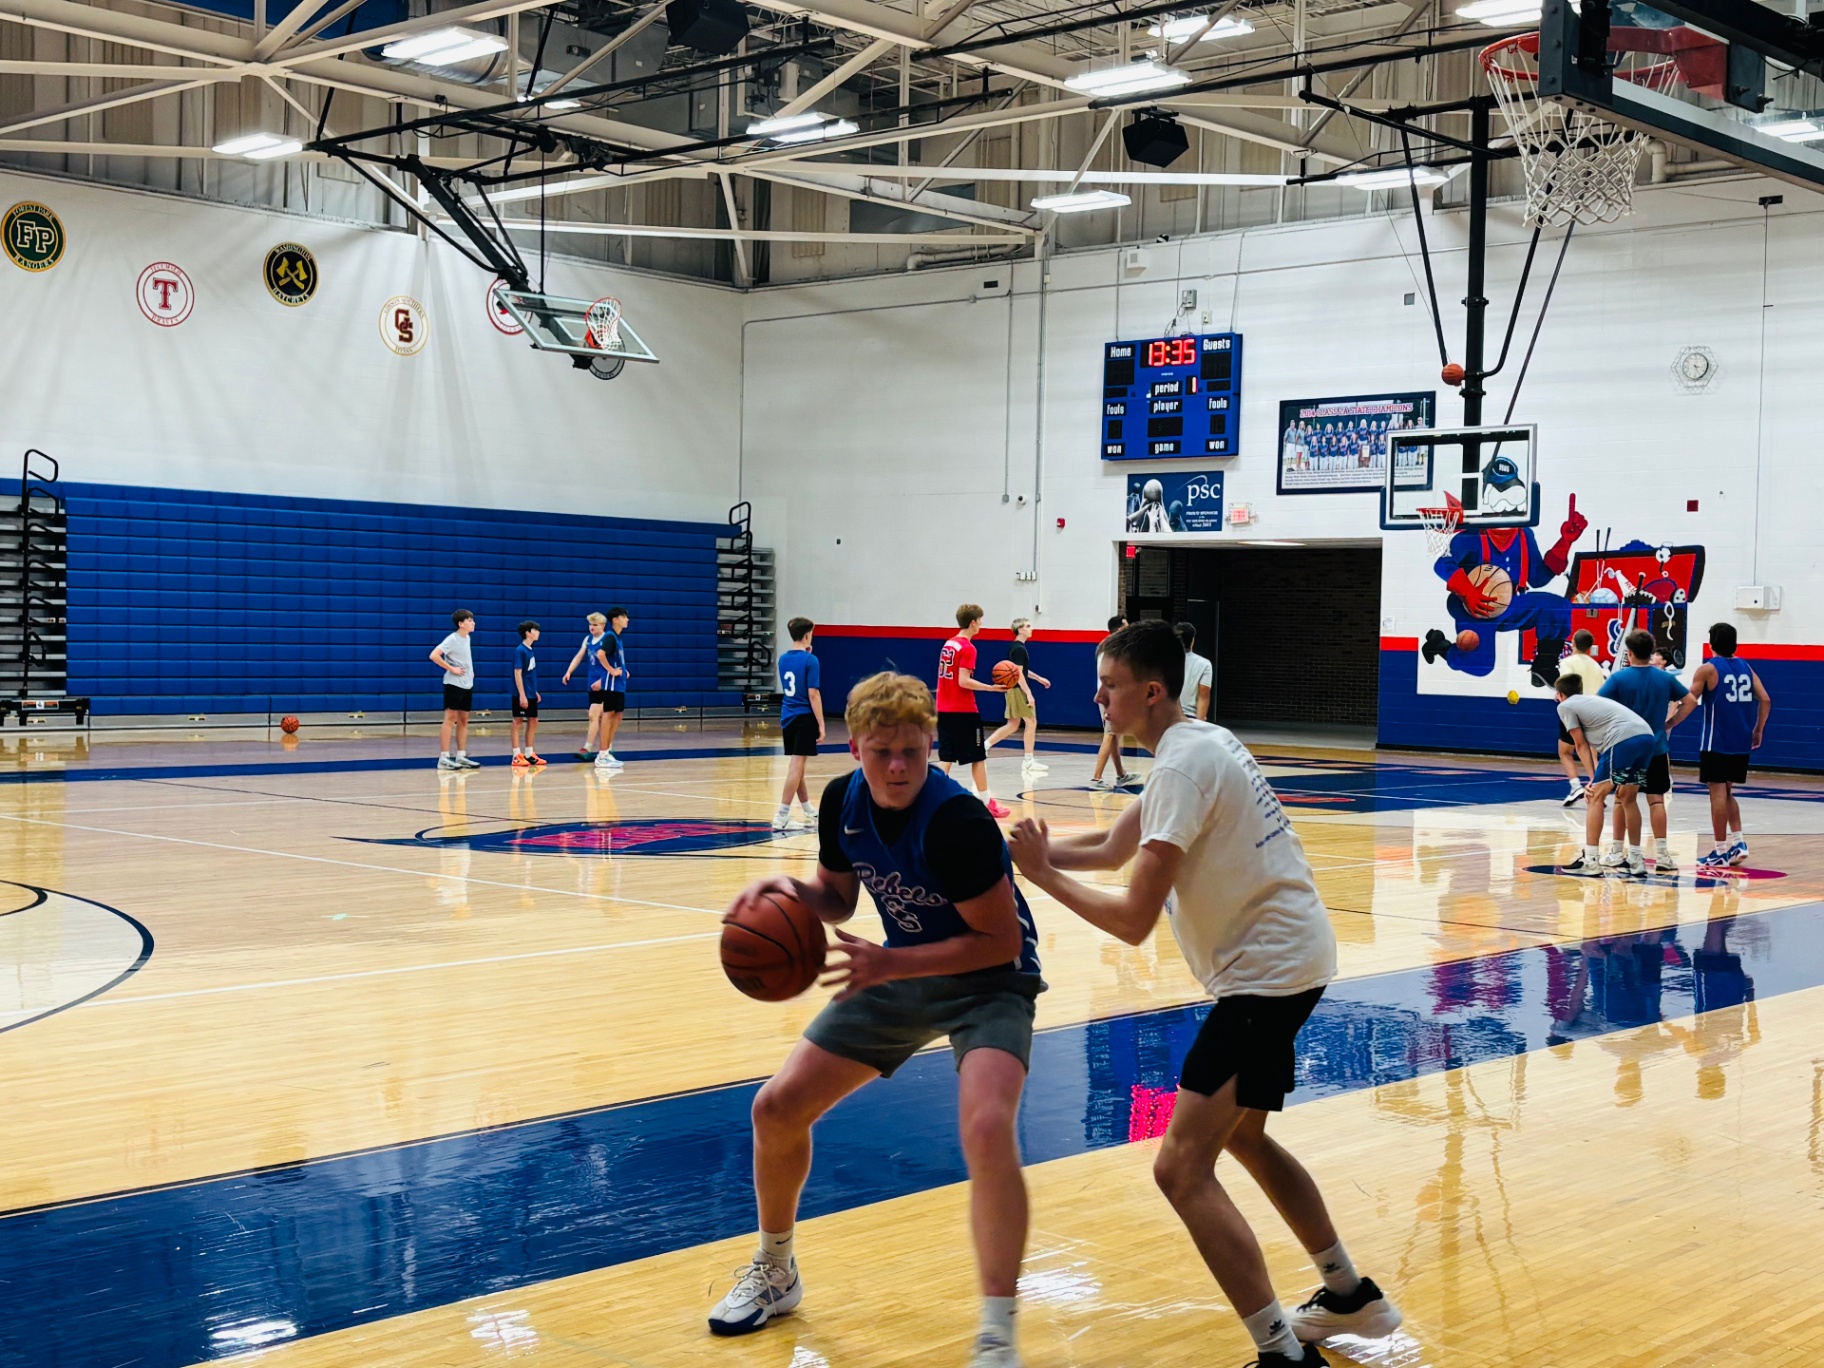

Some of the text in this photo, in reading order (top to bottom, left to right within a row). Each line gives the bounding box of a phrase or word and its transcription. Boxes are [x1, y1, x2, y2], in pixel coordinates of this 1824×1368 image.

[17, 219, 55, 253] FP
[153, 277, 178, 310] T
[1203, 339, 1231, 350] Guests
[1110, 346, 1131, 357] Home
[1148, 338, 1196, 366] 13:35
[1154, 381, 1179, 395] period
[1191, 376, 1197, 393] 1
[1106, 404, 1125, 415] fouls
[1153, 400, 1179, 413] player
[1208, 397, 1227, 409] fouls
[1107, 445, 1121, 454] won
[1154, 442, 1174, 454] game
[1208, 440, 1224, 449] won
[1186, 483, 1220, 506] psc
[784, 671, 796, 697] 3
[1724, 674, 1752, 702] 32
